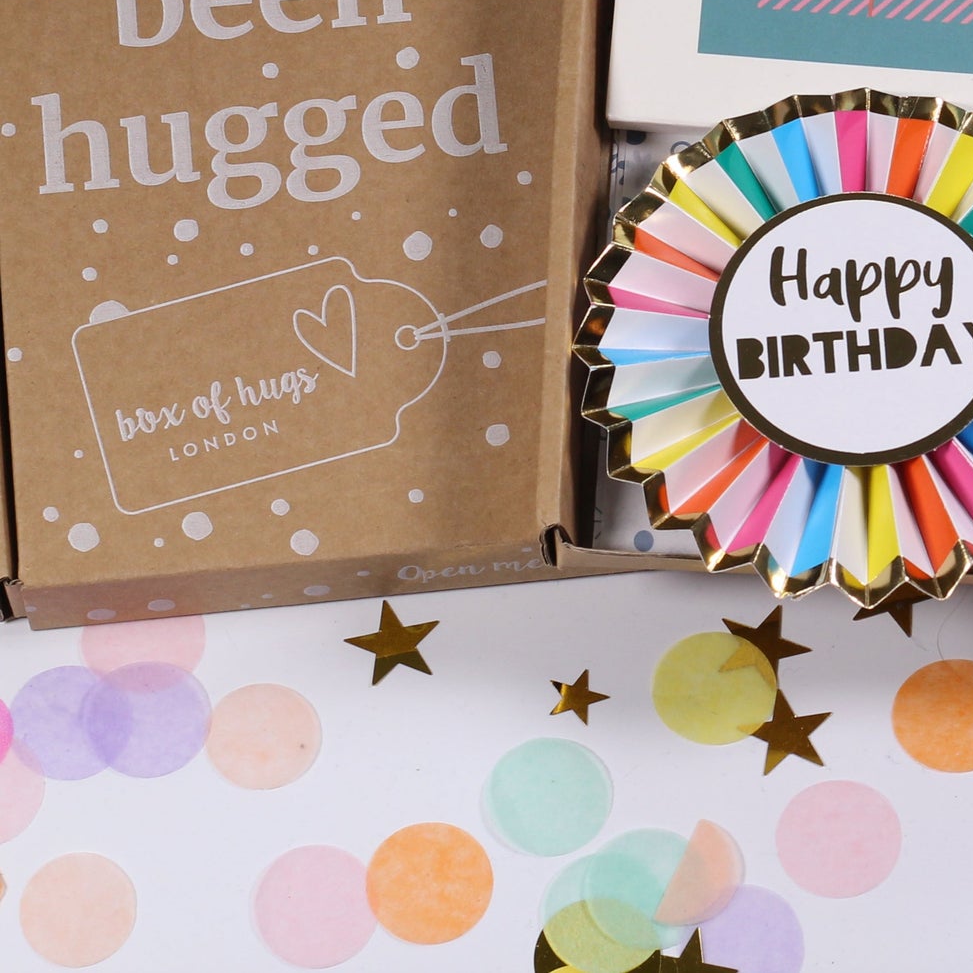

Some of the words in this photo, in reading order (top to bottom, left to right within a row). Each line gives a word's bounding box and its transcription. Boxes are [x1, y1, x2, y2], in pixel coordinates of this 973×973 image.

[31, 53, 508, 210] hugged
[769, 245, 955, 323] Happy
[115, 402, 186, 442] box
[192, 381, 231, 425] of
[234, 368, 319, 406] hugs
[169, 419, 279, 462] LONDON
[397, 564, 486, 584] Open
